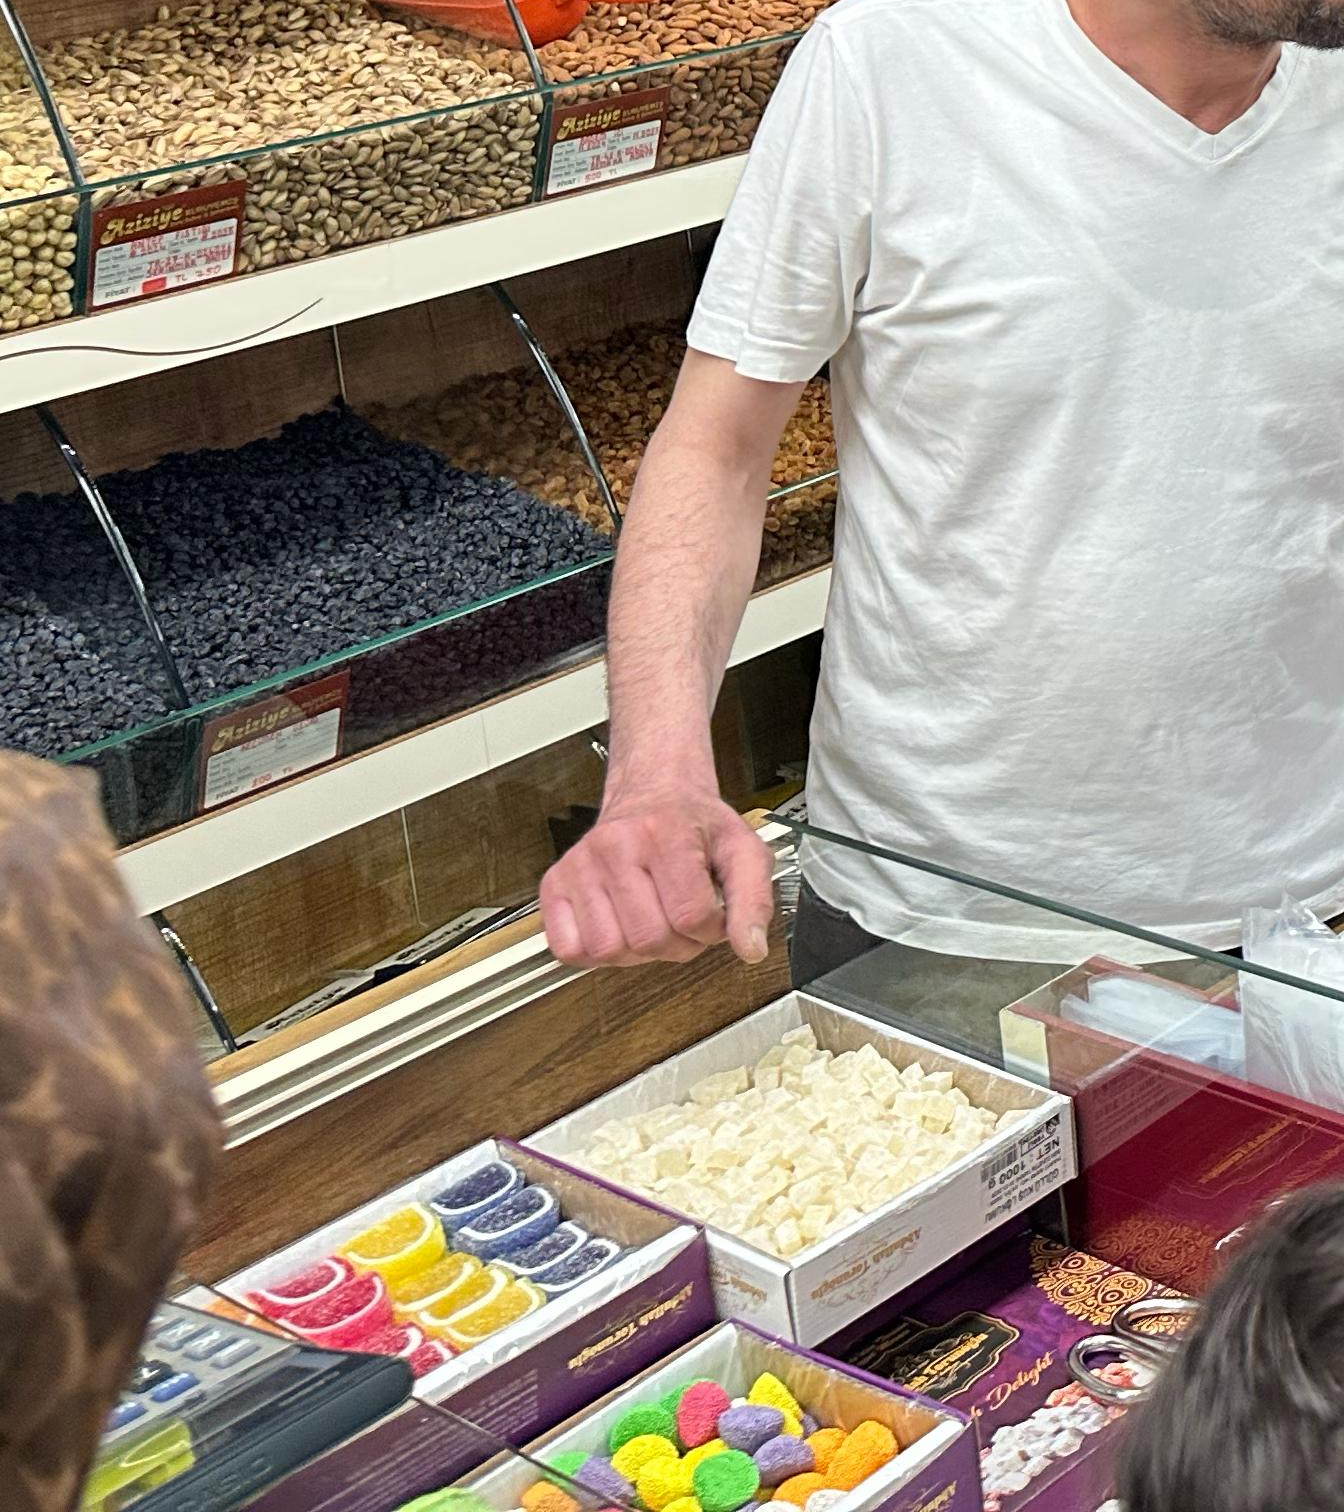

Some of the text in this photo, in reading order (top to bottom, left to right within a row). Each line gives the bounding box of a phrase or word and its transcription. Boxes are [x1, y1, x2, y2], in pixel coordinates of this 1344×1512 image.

[557, 109, 621, 140] Aziziye
[101, 206, 184, 246] Aziziye
[1036, 1135, 1060, 1159] NET
[999, 1160, 1027, 1185] 1000
[985, 1348, 1056, 1411] Delight
